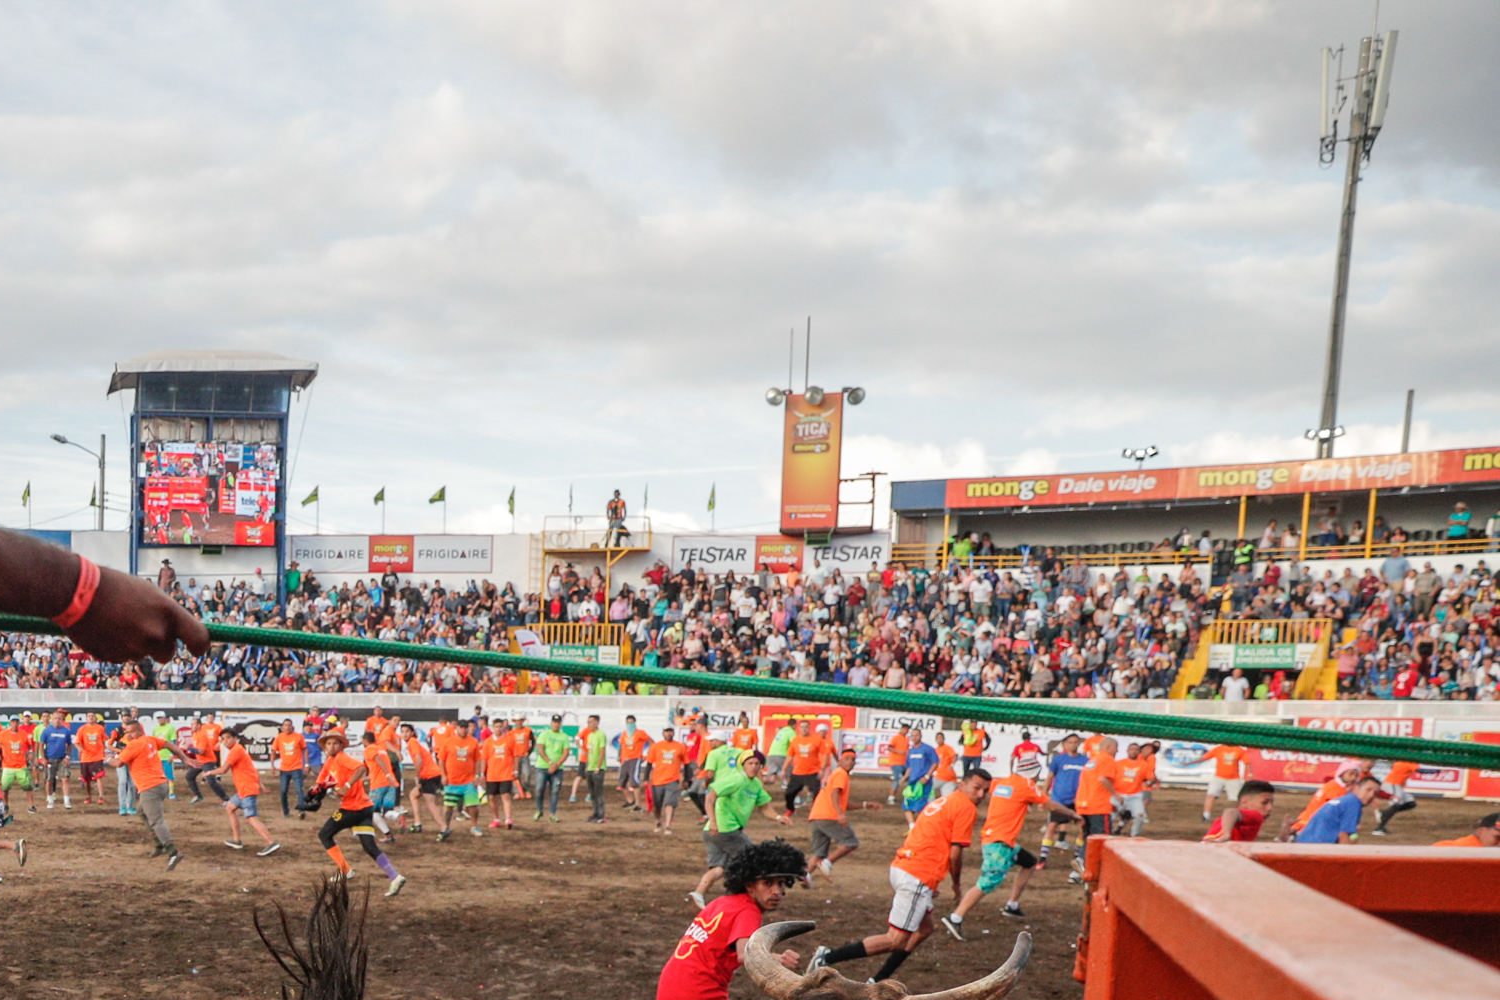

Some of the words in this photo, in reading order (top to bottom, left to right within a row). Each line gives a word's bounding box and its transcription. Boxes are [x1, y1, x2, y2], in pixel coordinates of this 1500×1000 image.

[796, 423, 828, 437] TICA
[1198, 467, 1290, 490] monge
[1299, 463, 1353, 483] Dale
[1355, 459, 1412, 481] viaje
[966, 479, 1049, 501] monge
[1057, 477, 1105, 494] Dale
[1107, 474, 1157, 494] viaje
[295, 549, 364, 559] FRIGIDAIRE
[373, 544, 409, 555] monge
[418, 549, 488, 559] FRIGIDAIRE
[680, 547, 747, 563] TELSTAR
[760, 544, 798, 556] monge
[813, 545, 882, 562] TELSTAR
[372, 555, 389, 563] Dale
[390, 555, 409, 565] viaje
[758, 555, 777, 564] Dale
[778, 555, 798, 565] viaje
[552, 648, 583, 656] SALIDA
[584, 648, 597, 656] DE
[1237, 647, 1276, 656] SALIDA
[1277, 647, 1293, 656] DE
[874, 717, 936, 730] TELSTAR
[245, 744, 266, 754] TORO
